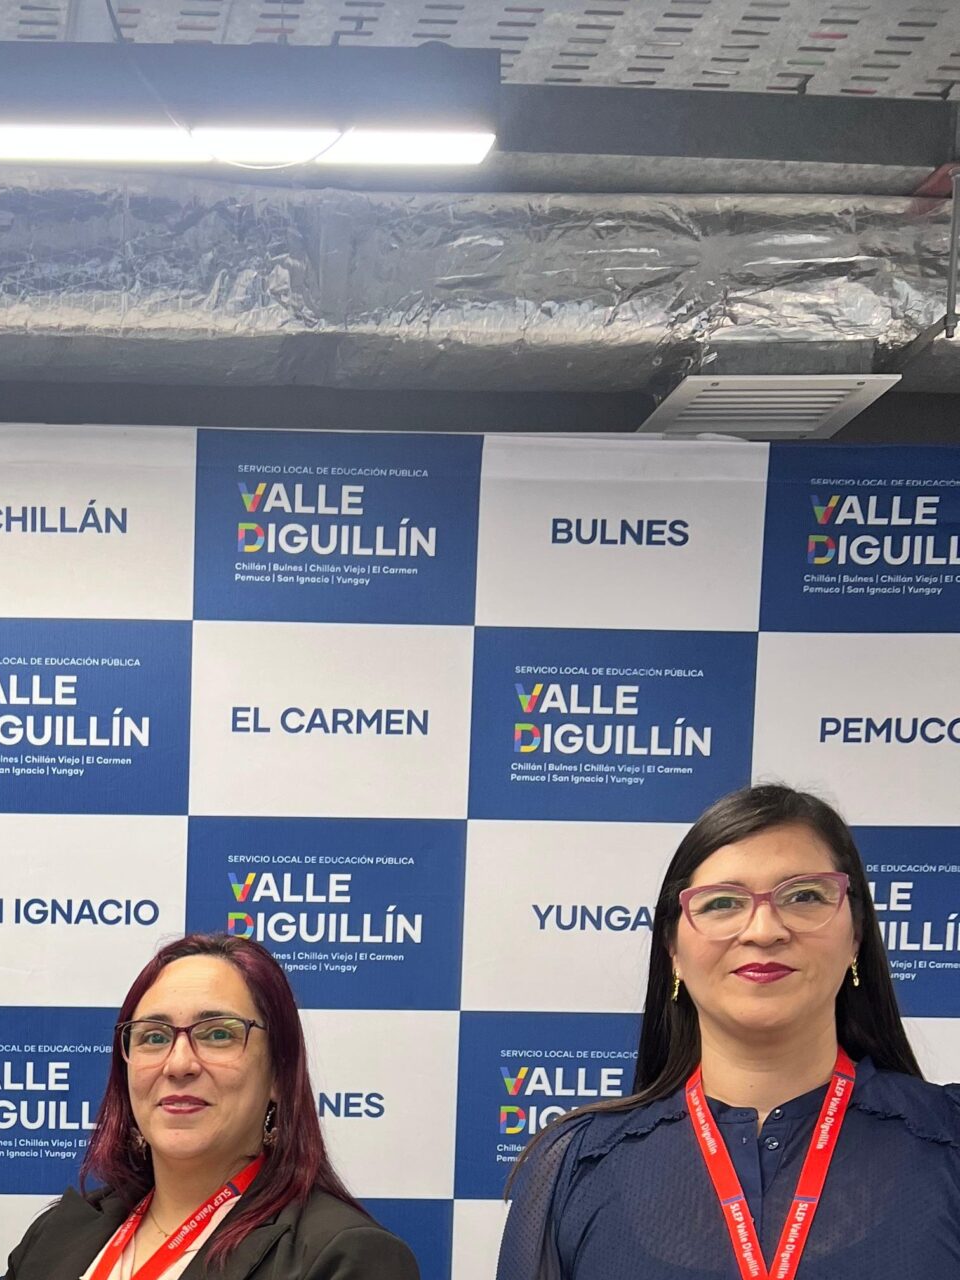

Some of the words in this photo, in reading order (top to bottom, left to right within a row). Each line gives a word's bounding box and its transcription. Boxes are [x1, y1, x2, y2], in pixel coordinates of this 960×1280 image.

[236, 482, 364, 515] VALLE
[810, 495, 940, 525] VALLE
[236, 518, 437, 557] DIGUILLÍN
[552, 518, 689, 546] BULNES
[807, 535, 960, 565] DIGUILL
[30, 657, 43, 666] DE
[44, 656, 99, 666] EDUCACIÓN
[101, 656, 141, 667] PÚBLICA
[514, 667, 558, 675] SERVICIO
[559, 667, 590, 675] LOCAL
[592, 668, 605, 676] DE
[606, 666, 662, 676] EDUCACIÓN
[663, 666, 704, 677] PÚBLICA
[514, 683, 639, 715] VALLE
[232, 707, 270, 733] EL
[281, 707, 429, 735] CARMEN
[513, 717, 713, 757] DIGUILLÍN
[227, 855, 271, 864] SERVICIO
[272, 856, 303, 864] LOCAL
[304, 856, 317, 864] DE
[319, 854, 373, 865] EDUCACIÓN
[375, 854, 415, 865] PÚBLICA
[226, 872, 352, 903] VALLE
[15, 898, 159, 926] IGNACIO
[226, 905, 423, 943] DIGUILLÍN
[532, 904, 658, 931] YUNGA
[24, 1045, 36, 1053] DE
[38, 1043, 92, 1053] EDUCACIÓN
[500, 1049, 542, 1058] SERVICIO
[544, 1050, 574, 1058] LOCAL
[576, 1050, 589, 1058] DE
[499, 1066, 624, 1097] VALLE
[833, 1077, 846, 1097] SLEP
[318, 1092, 385, 1118] NES
[212, 1187, 231, 1207] SLEP
[729, 1202, 743, 1223] SLEP
[794, 1201, 808, 1222] SLEP
